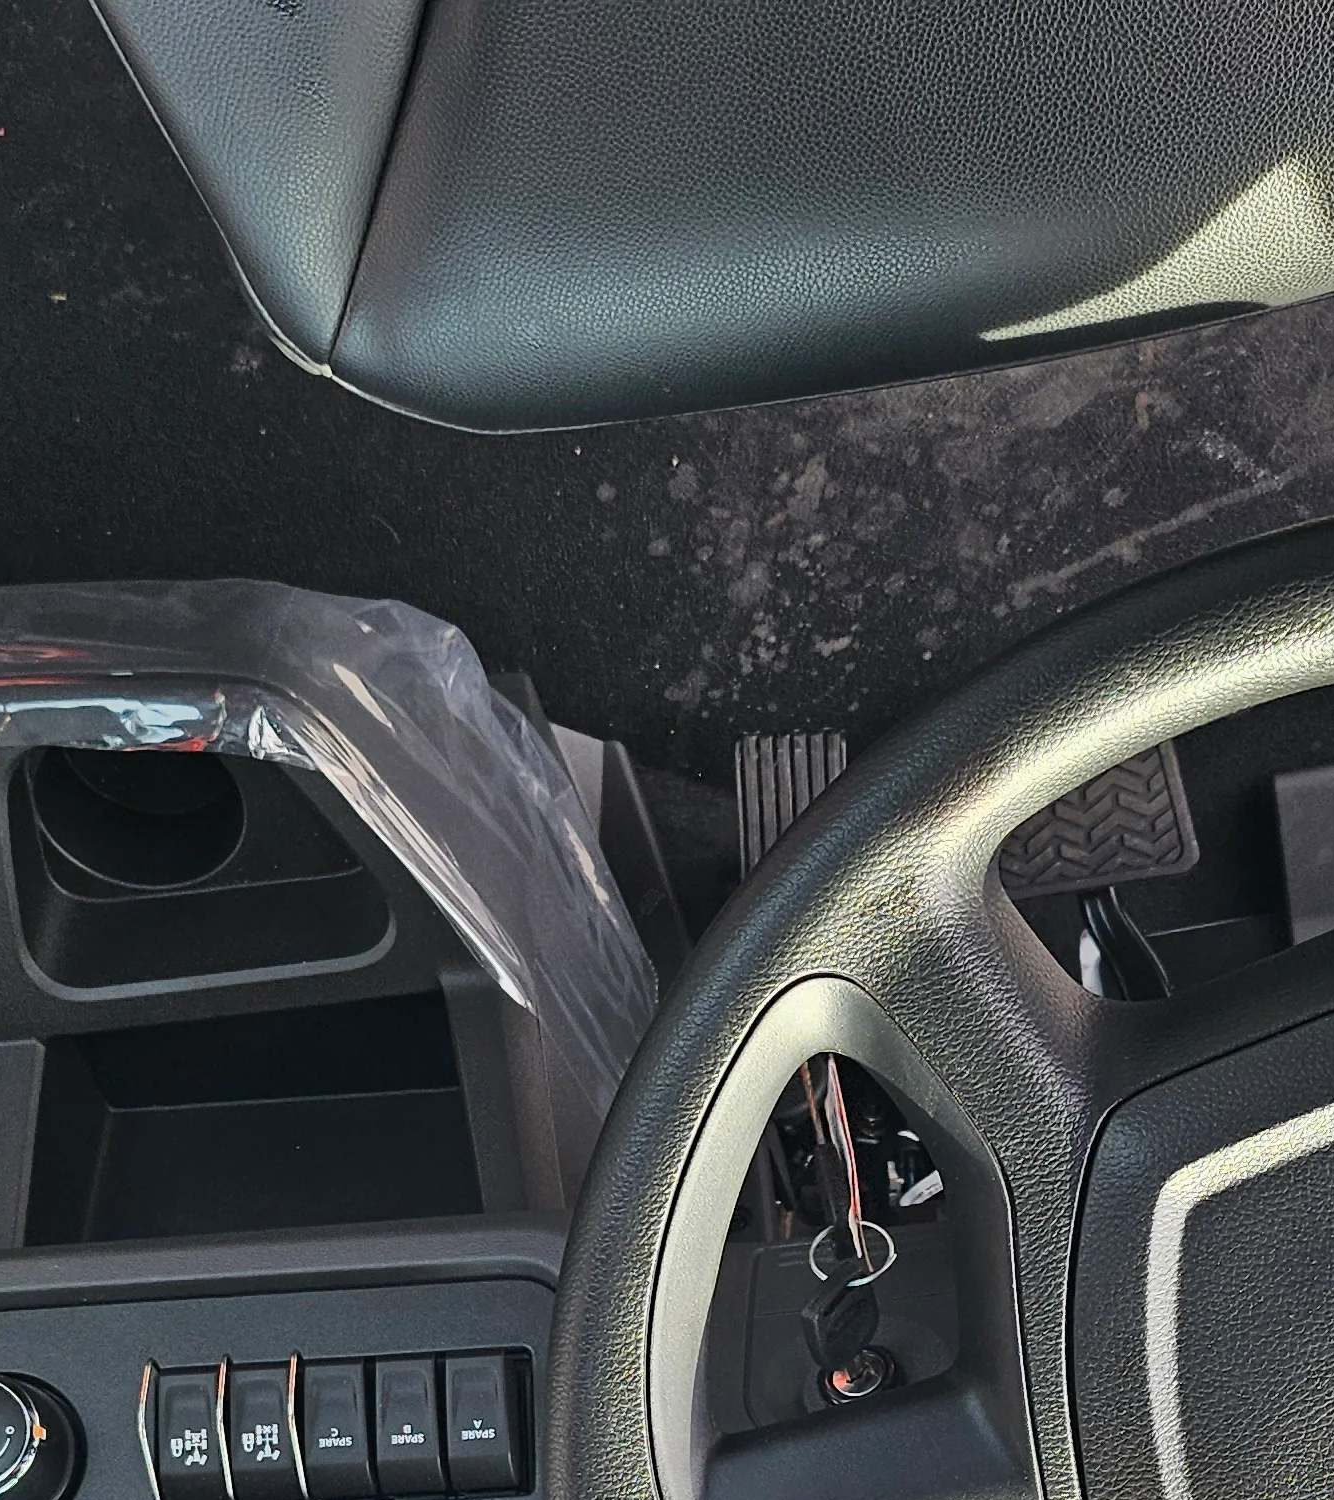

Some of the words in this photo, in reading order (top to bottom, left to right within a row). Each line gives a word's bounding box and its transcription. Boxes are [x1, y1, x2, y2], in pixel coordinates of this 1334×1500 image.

[403, 1424, 411, 1435] B
[472, 1419, 483, 1430] A
[330, 1426, 339, 1438] C
[461, 1428, 495, 1441] SPARE
[319, 1435, 353, 1448] SPARE
[391, 1432, 425, 1445] SPARE
